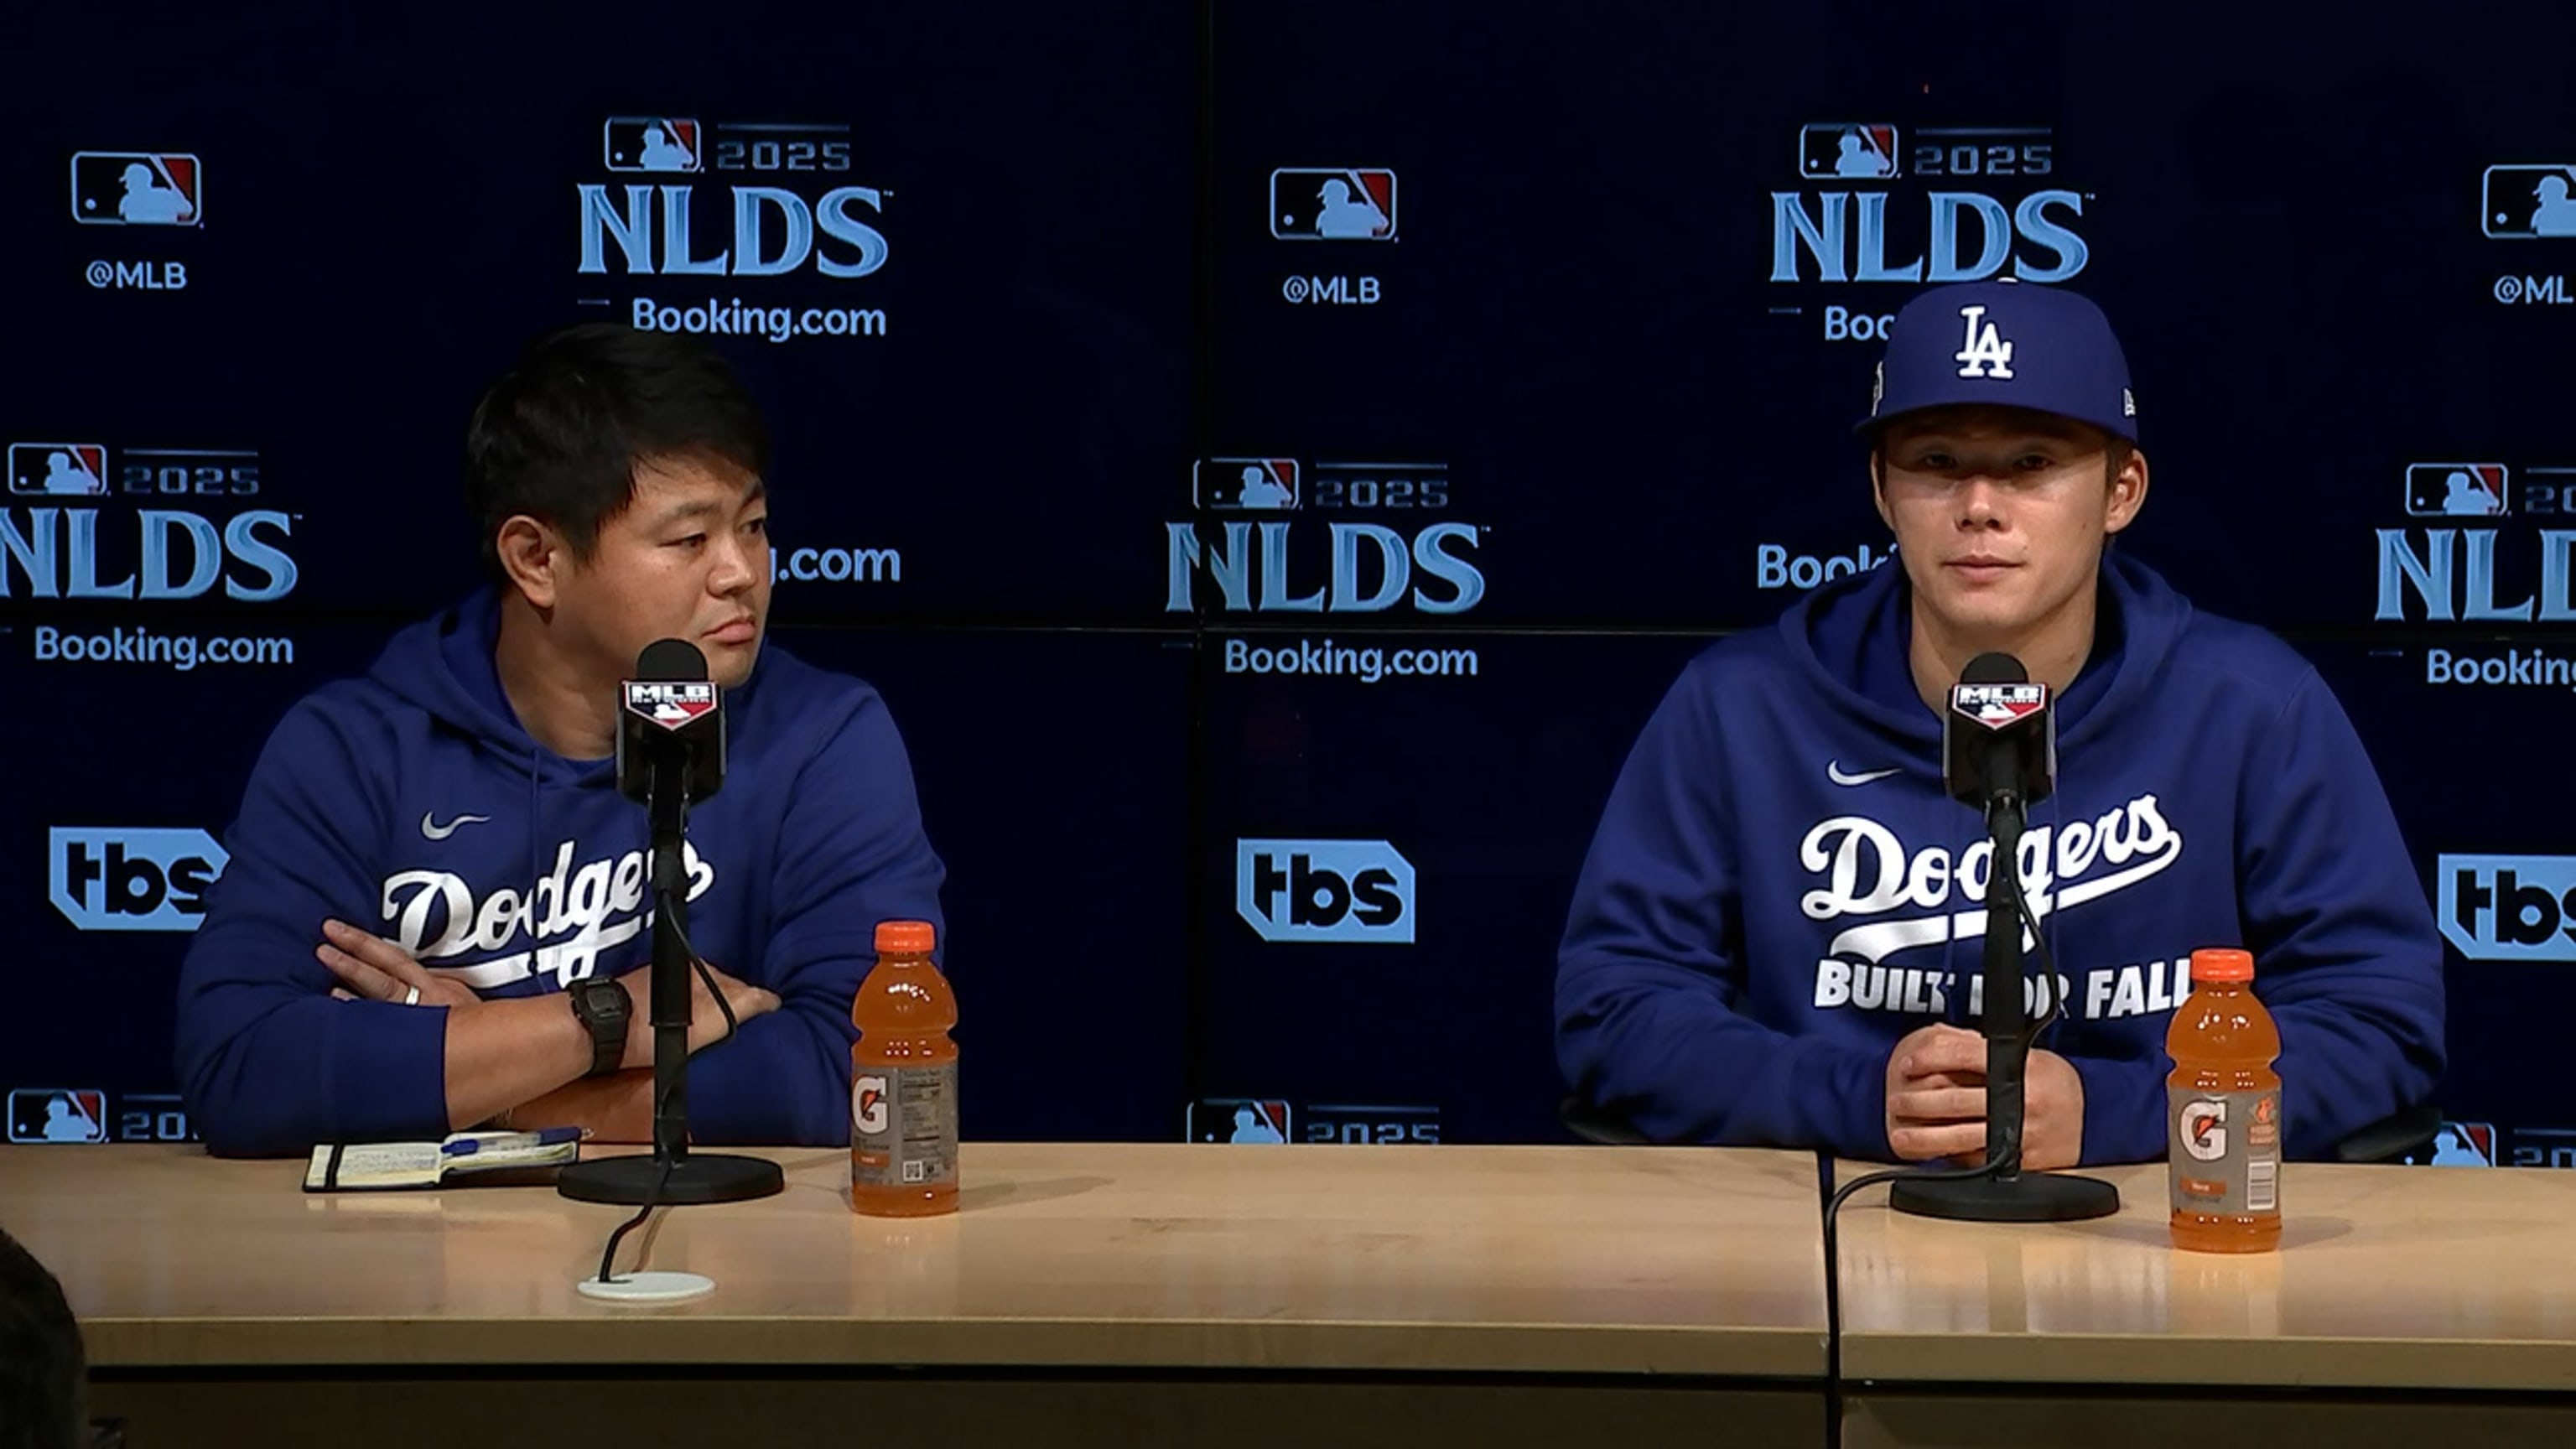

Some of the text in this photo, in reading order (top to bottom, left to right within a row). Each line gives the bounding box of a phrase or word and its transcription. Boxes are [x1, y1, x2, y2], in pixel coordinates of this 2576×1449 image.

[717, 142, 850, 170] 2025
[1914, 145, 2052, 174] 2025
[576, 183, 889, 278] NLDS
[1769, 189, 2090, 283] NLDS
[86, 261, 188, 289] @MLB
[1282, 275, 1381, 304] @MLB
[2493, 275, 2574, 304] @ML
[632, 298, 886, 343] Booking.com
[1955, 306, 2013, 379] LA
[124, 467, 259, 495] 2025
[1315, 480, 1448, 508] 2025
[0, 507, 299, 601] NLDS
[1165, 522, 1485, 614] NLDS
[35, 626, 293, 671] Booking.com
[1225, 638, 1478, 683] Booking.com
[2427, 648, 2576, 693] Bookin
[66, 841, 215, 916] tbs
[1253, 853, 1404, 927] tbs
[382, 839, 715, 989] Dodges
[2456, 870, 2576, 945] tb
[122, 1112, 199, 1140] 20
[852, 1076, 889, 1135] G
[2180, 1101, 2227, 1161] G
